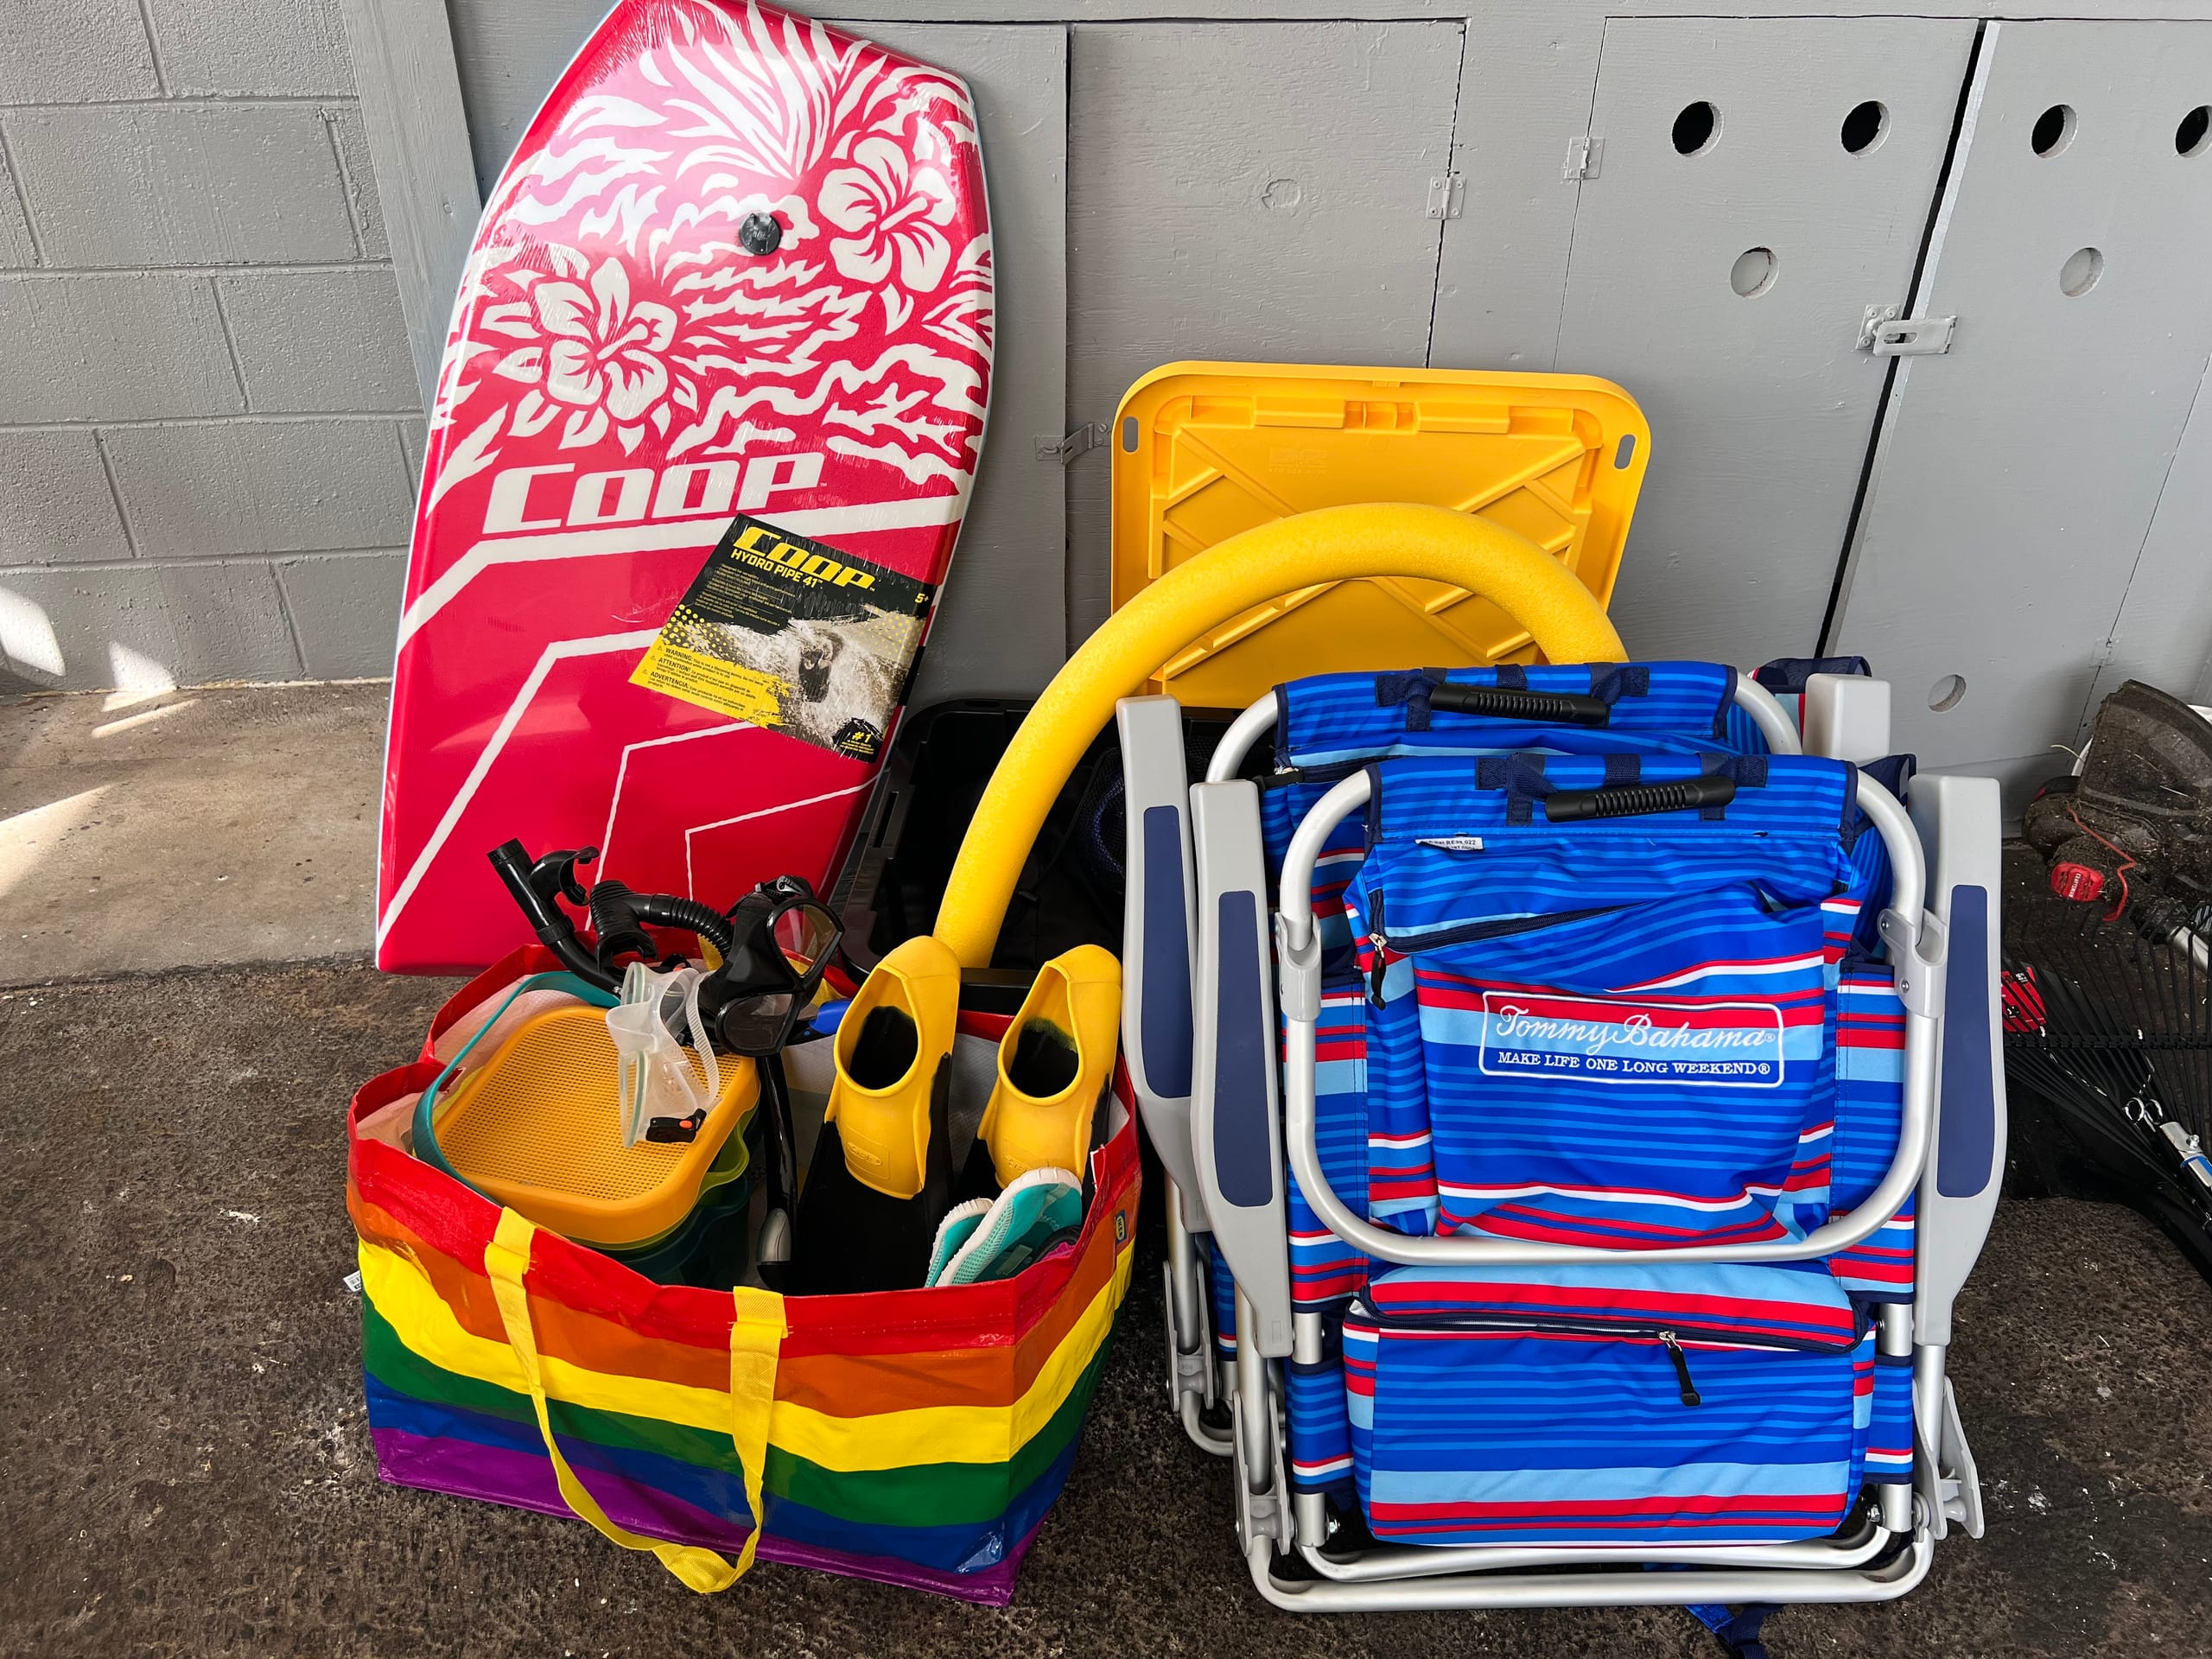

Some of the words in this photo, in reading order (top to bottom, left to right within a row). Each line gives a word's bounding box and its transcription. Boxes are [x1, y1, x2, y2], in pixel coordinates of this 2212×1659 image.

[731, 549, 774, 572] HYDRO
[774, 564, 803, 583] PIPE
[658, 658, 691, 672] ATTENTION!
[665, 648, 693, 662] WARNING:
[1497, 1004, 1609, 1056] Tommy
[1498, 1051, 1541, 1065] MAKE
[1544, 1054, 1580, 1068] LIFE
[1586, 1058, 1618, 1071] ONE
[1622, 1060, 1669, 1074] LONG
